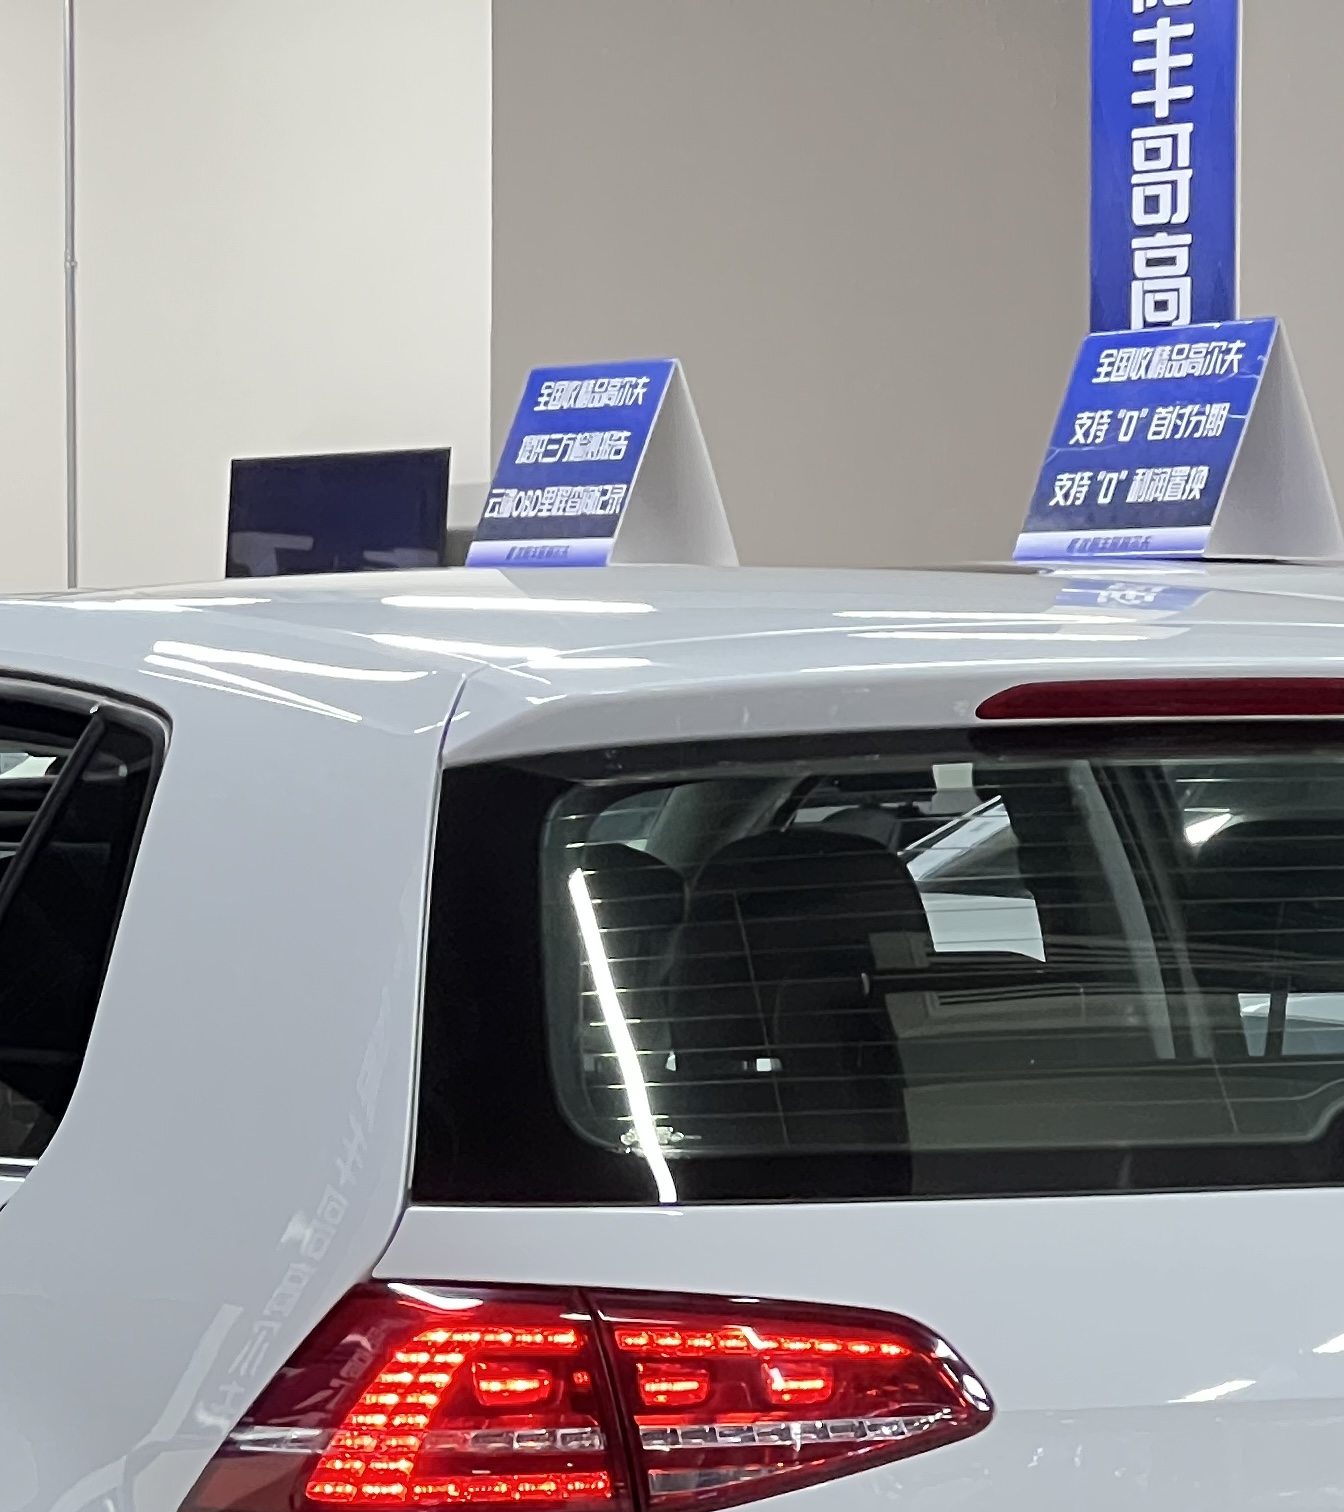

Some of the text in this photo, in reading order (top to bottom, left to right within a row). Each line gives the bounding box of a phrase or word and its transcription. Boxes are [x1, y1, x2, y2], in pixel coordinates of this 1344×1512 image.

[1130, 0, 1195, 330] 丰哥高
[1091, 340, 1246, 383] 全国收精品高尔夫
